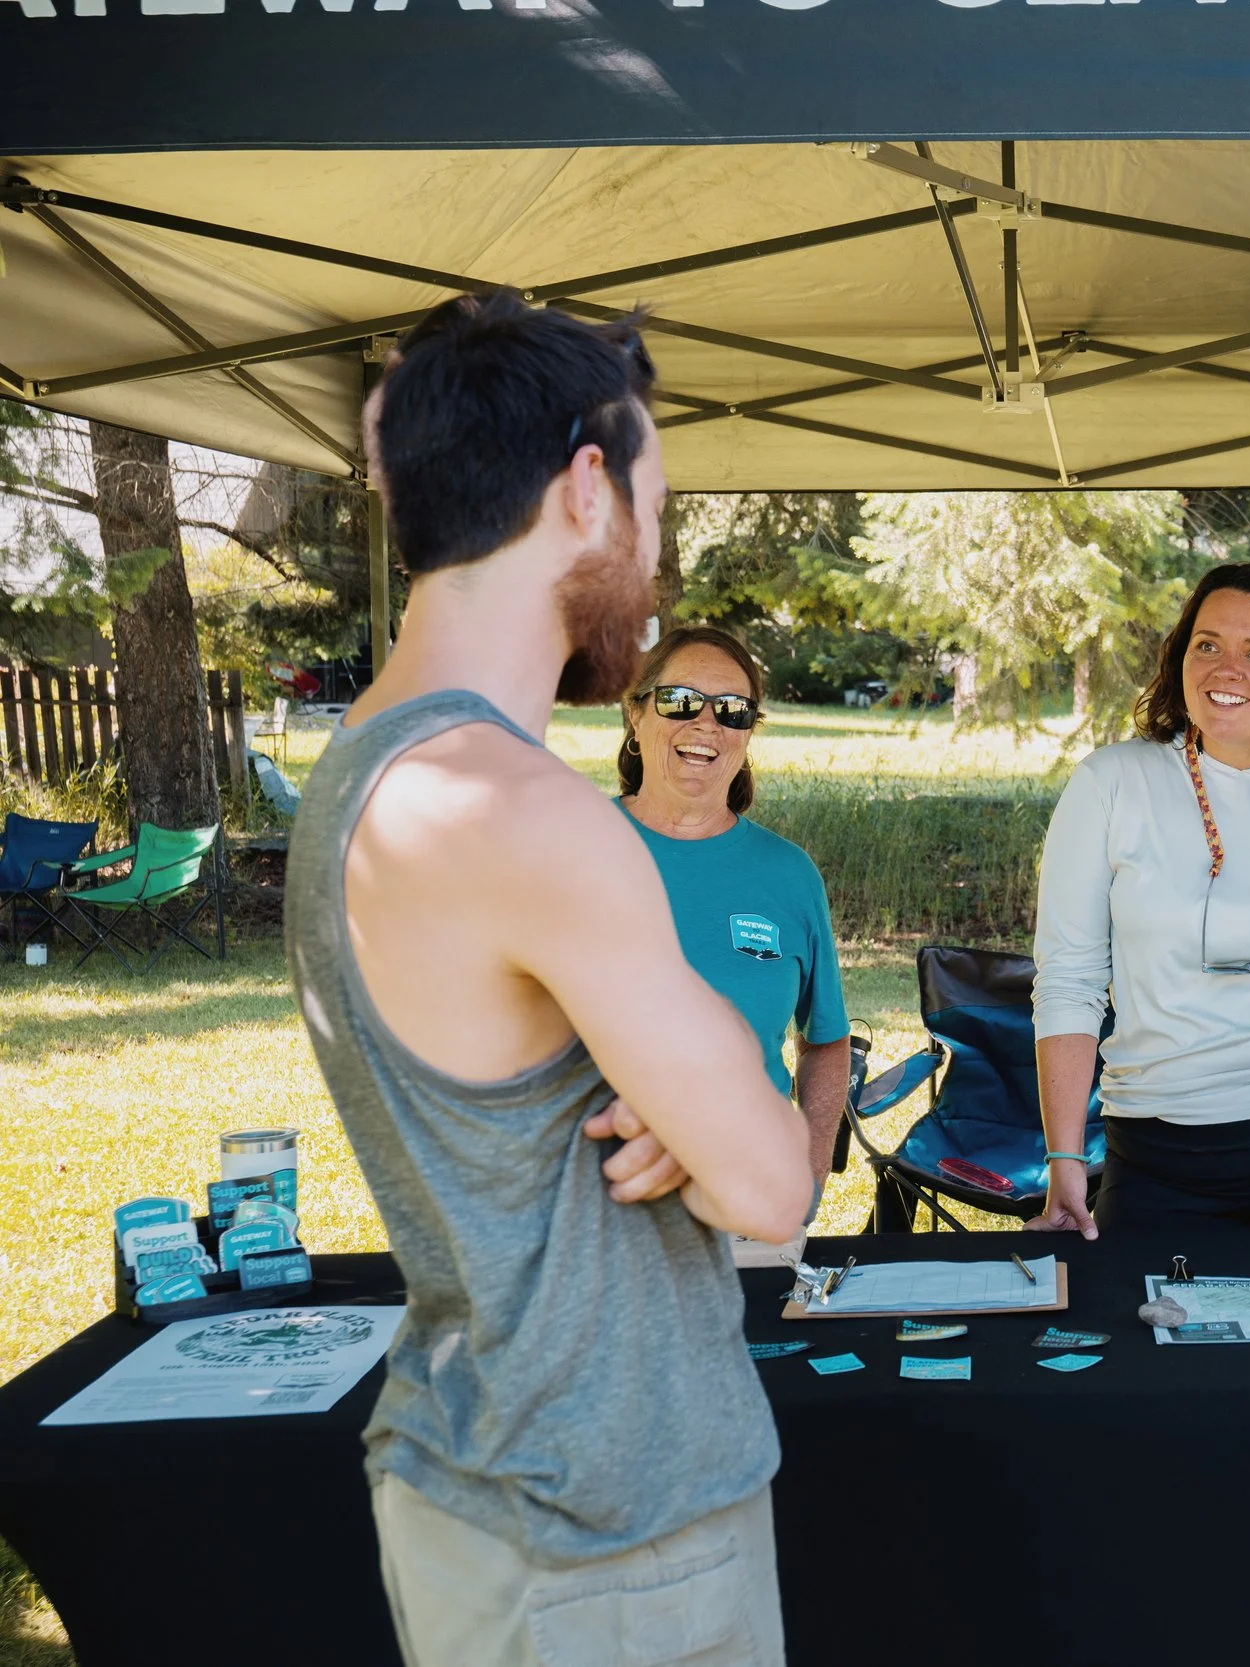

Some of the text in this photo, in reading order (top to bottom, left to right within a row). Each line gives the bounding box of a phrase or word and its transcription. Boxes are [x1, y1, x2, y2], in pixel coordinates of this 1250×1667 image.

[736, 919, 773, 932] GATEWAY
[740, 931, 772, 943] GLACIER
[211, 1181, 270, 1199] Support
[133, 1233, 188, 1247] Support
[231, 1231, 273, 1243] GATEWAY
[245, 1253, 304, 1271] Support
[247, 1268, 281, 1285] local
[210, 1311, 301, 1330] CEDAR
[1046, 1327, 1104, 1341] Support
[264, 1346, 335, 1361] TROT
[198, 1361, 248, 1370] August
